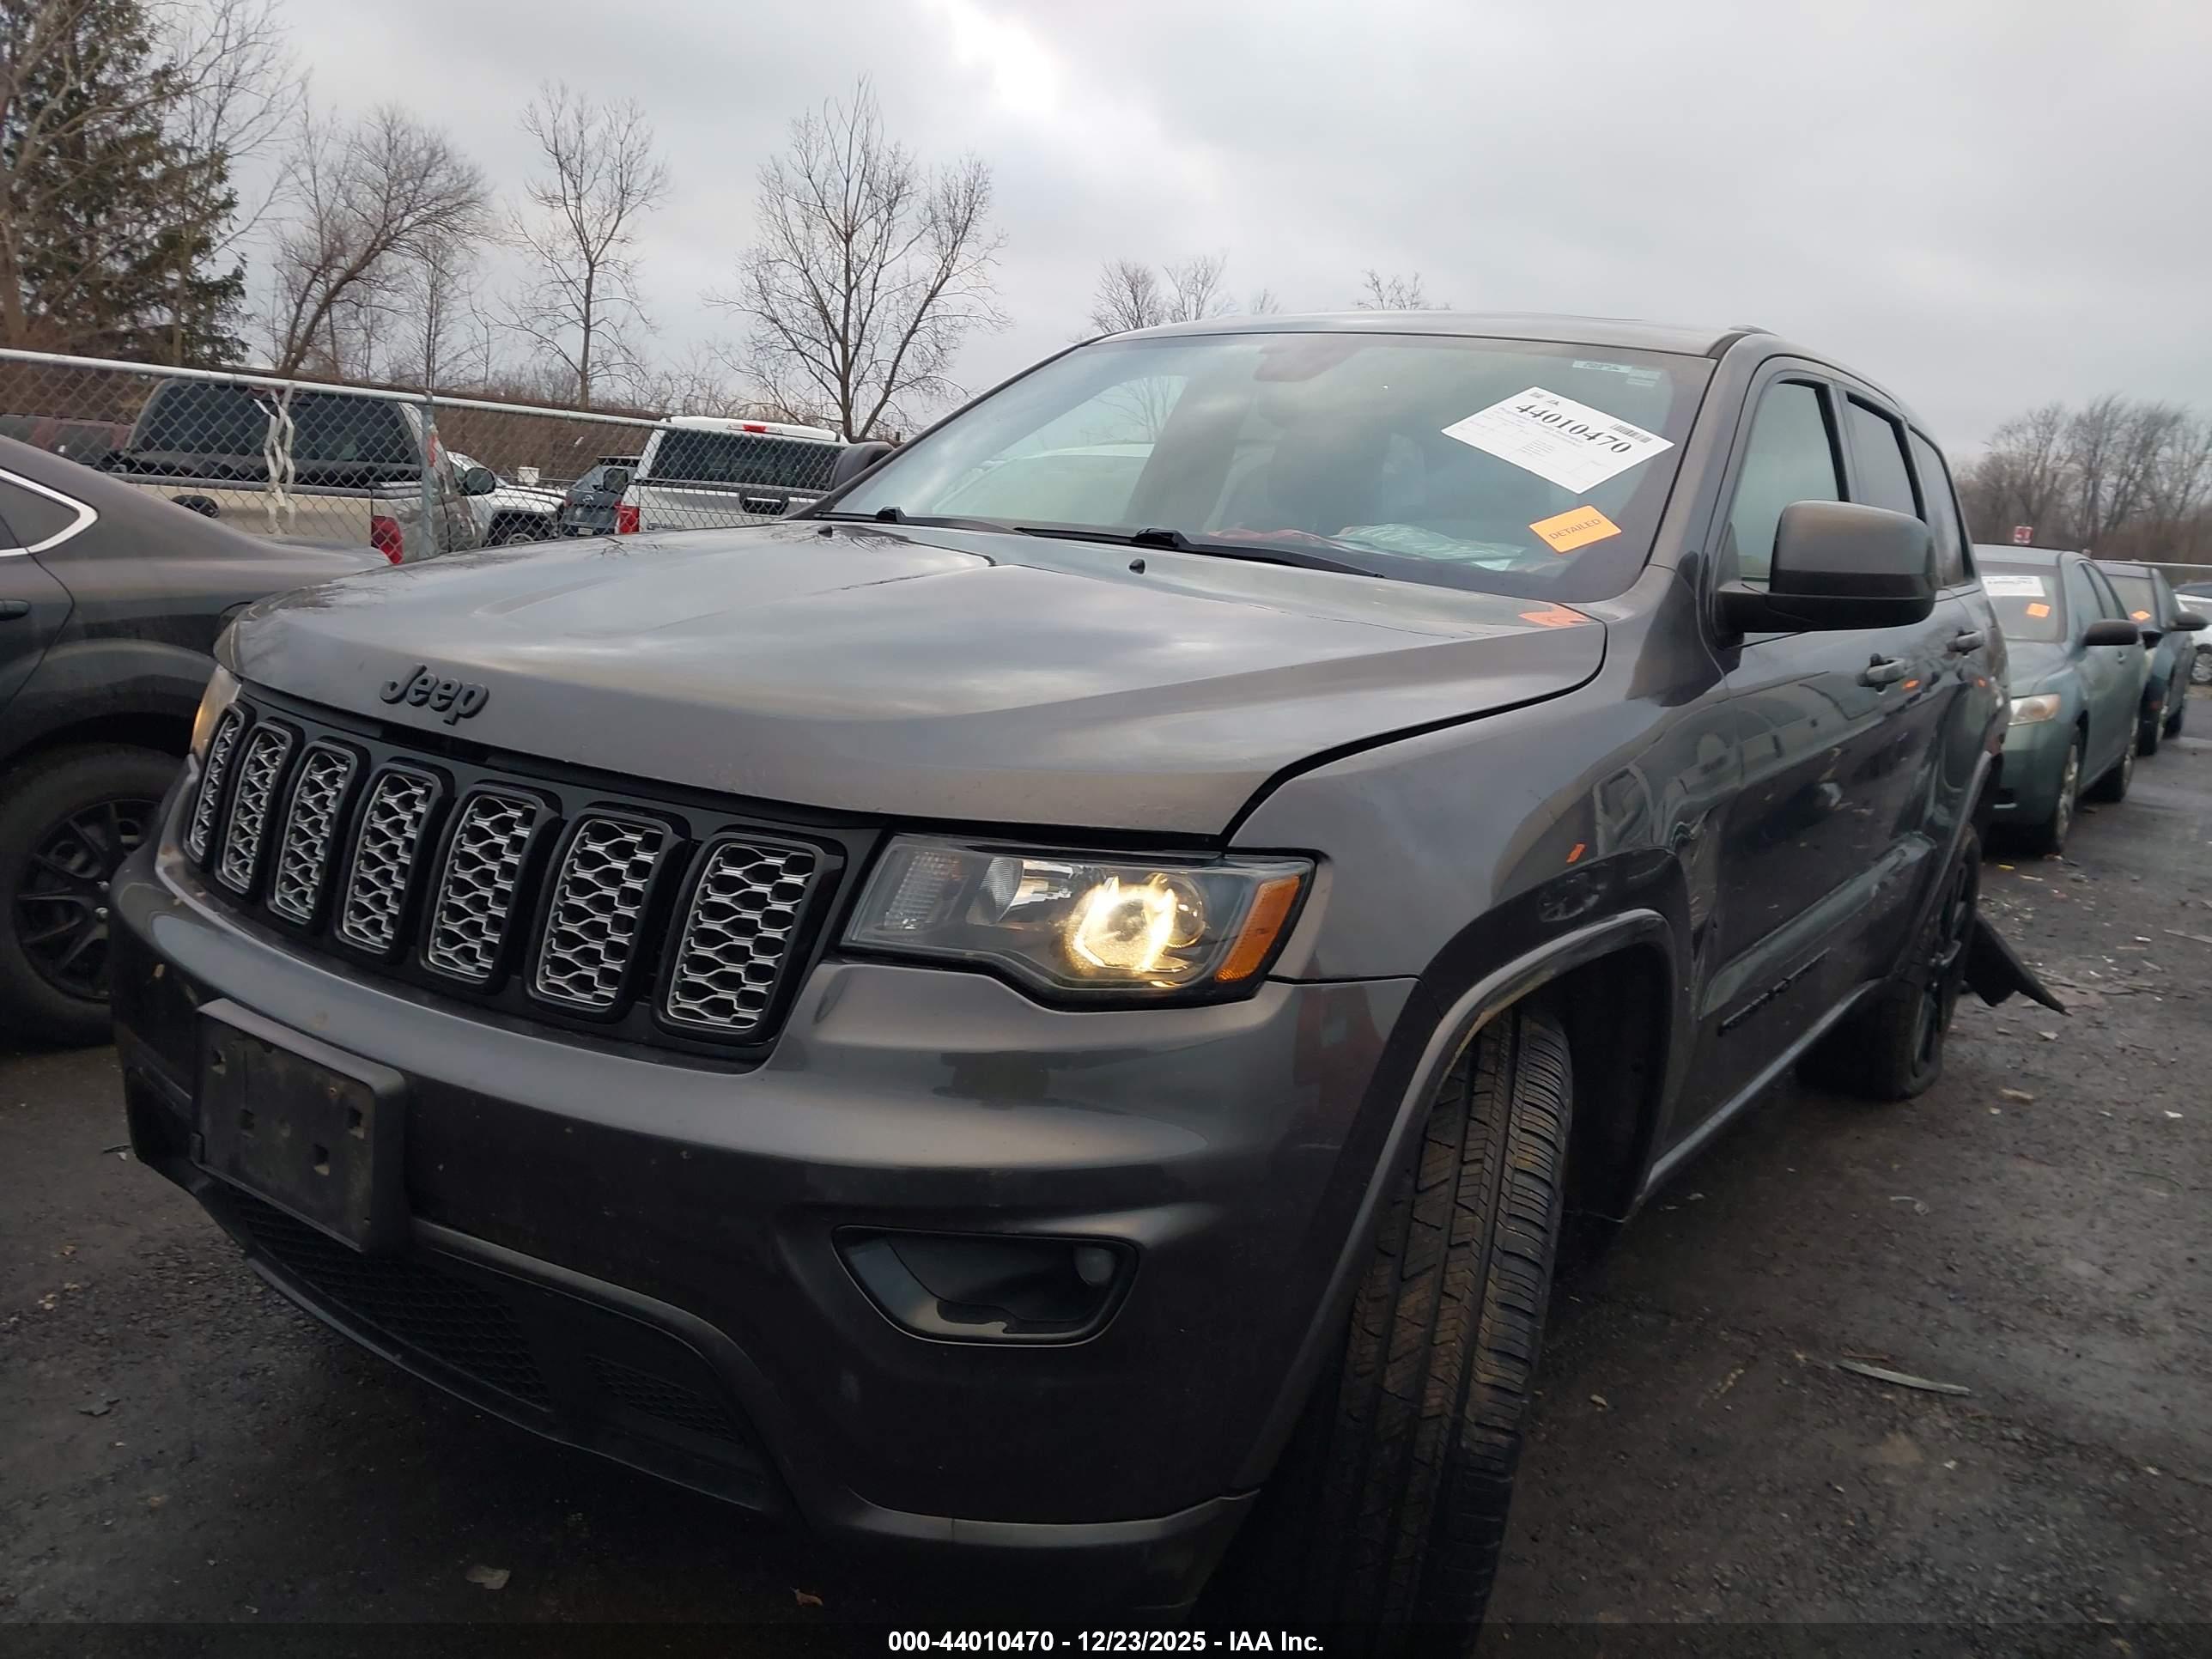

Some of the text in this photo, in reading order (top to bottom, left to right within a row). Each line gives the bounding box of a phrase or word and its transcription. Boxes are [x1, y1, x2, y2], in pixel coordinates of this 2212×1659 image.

[1515, 404, 1632, 453] 44010470
[1548, 518, 1601, 540] DETAILED
[380, 662, 489, 726] Jeep
